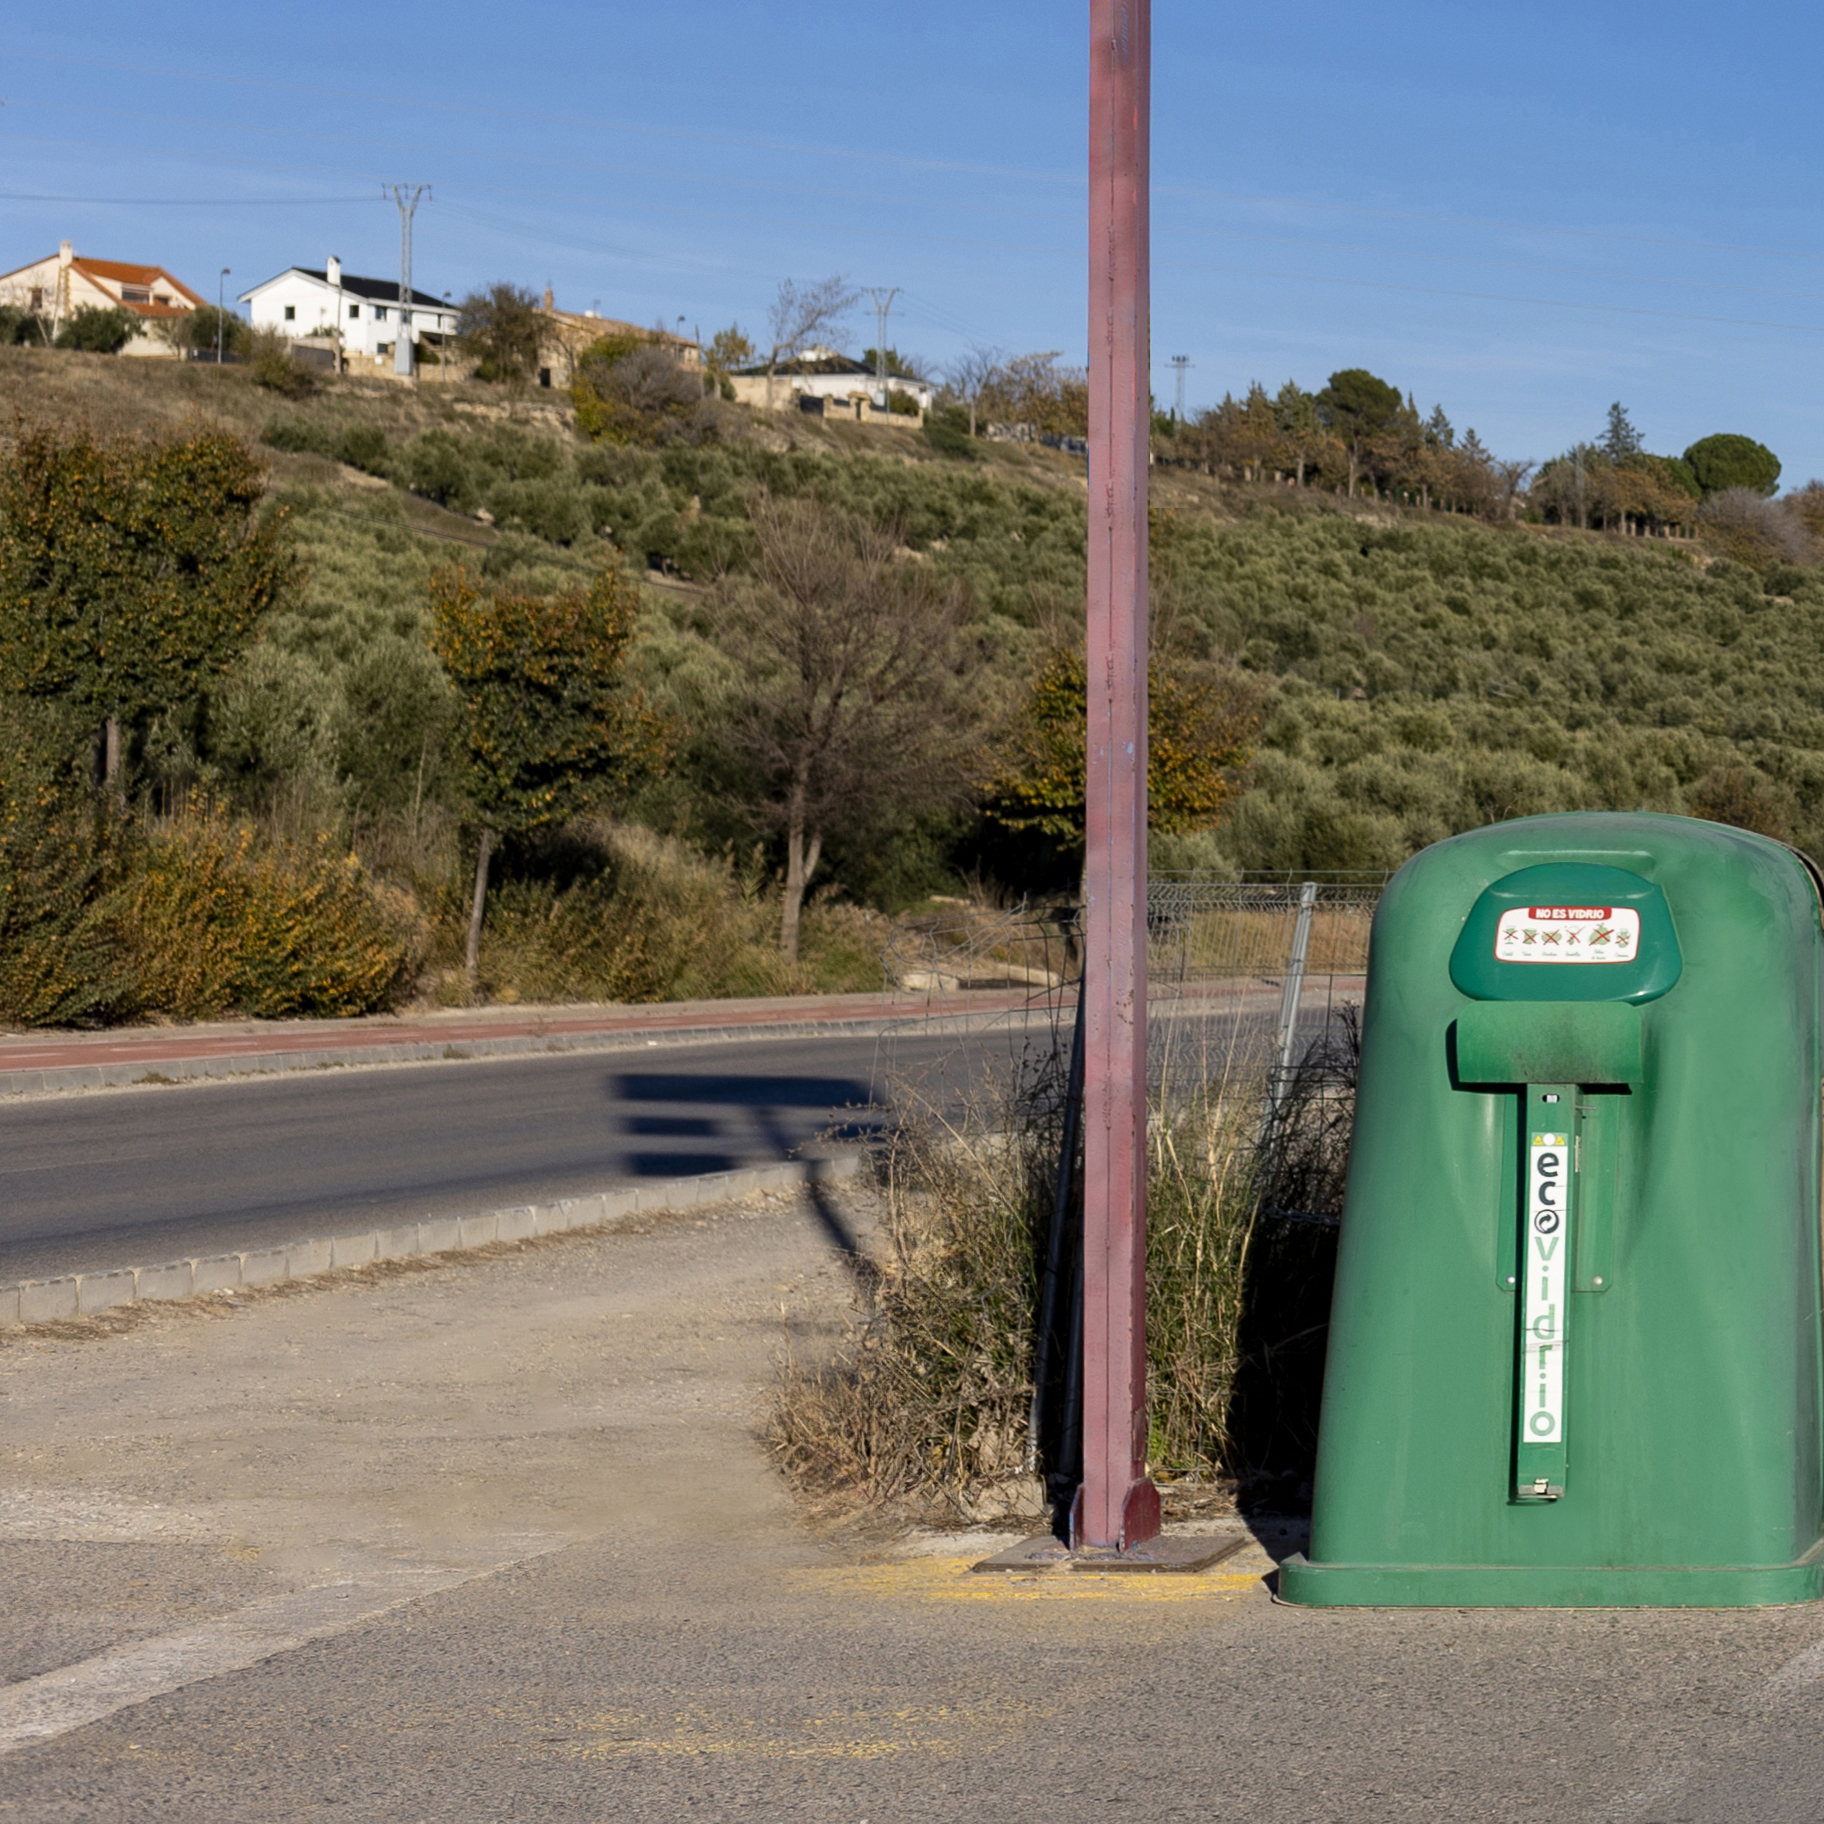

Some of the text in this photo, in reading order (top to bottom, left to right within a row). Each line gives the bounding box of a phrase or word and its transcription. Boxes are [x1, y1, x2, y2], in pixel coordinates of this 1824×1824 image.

[1535, 908, 1605, 919] NO ES VIDRIO
